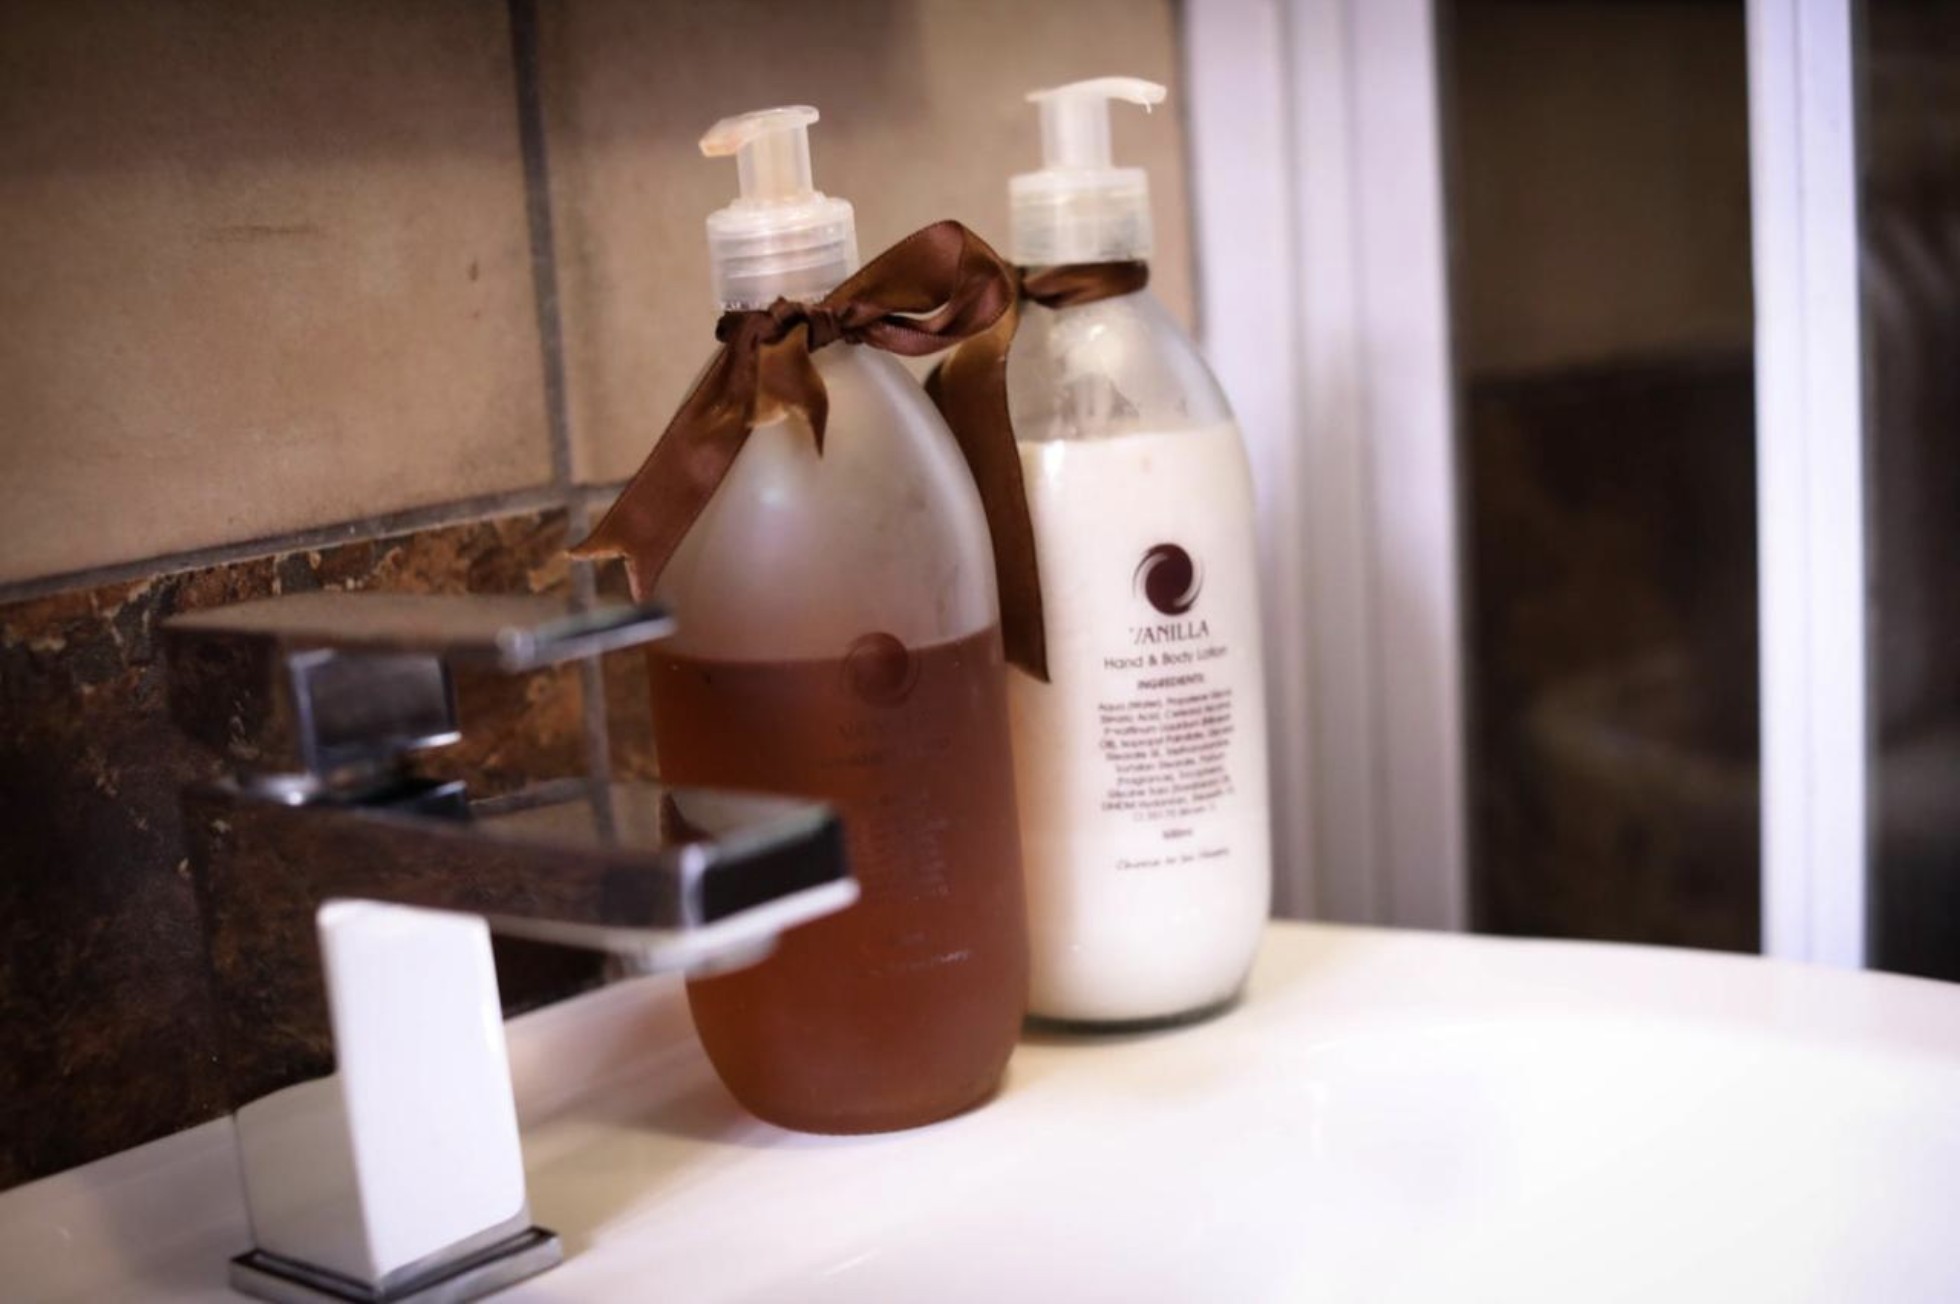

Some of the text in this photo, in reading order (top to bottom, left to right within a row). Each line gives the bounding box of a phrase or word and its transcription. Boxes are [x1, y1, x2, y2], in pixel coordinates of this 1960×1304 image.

[1103, 656, 1143, 670] Hand
[1148, 655, 1158, 667] &
[1162, 652, 1194, 666] Body
